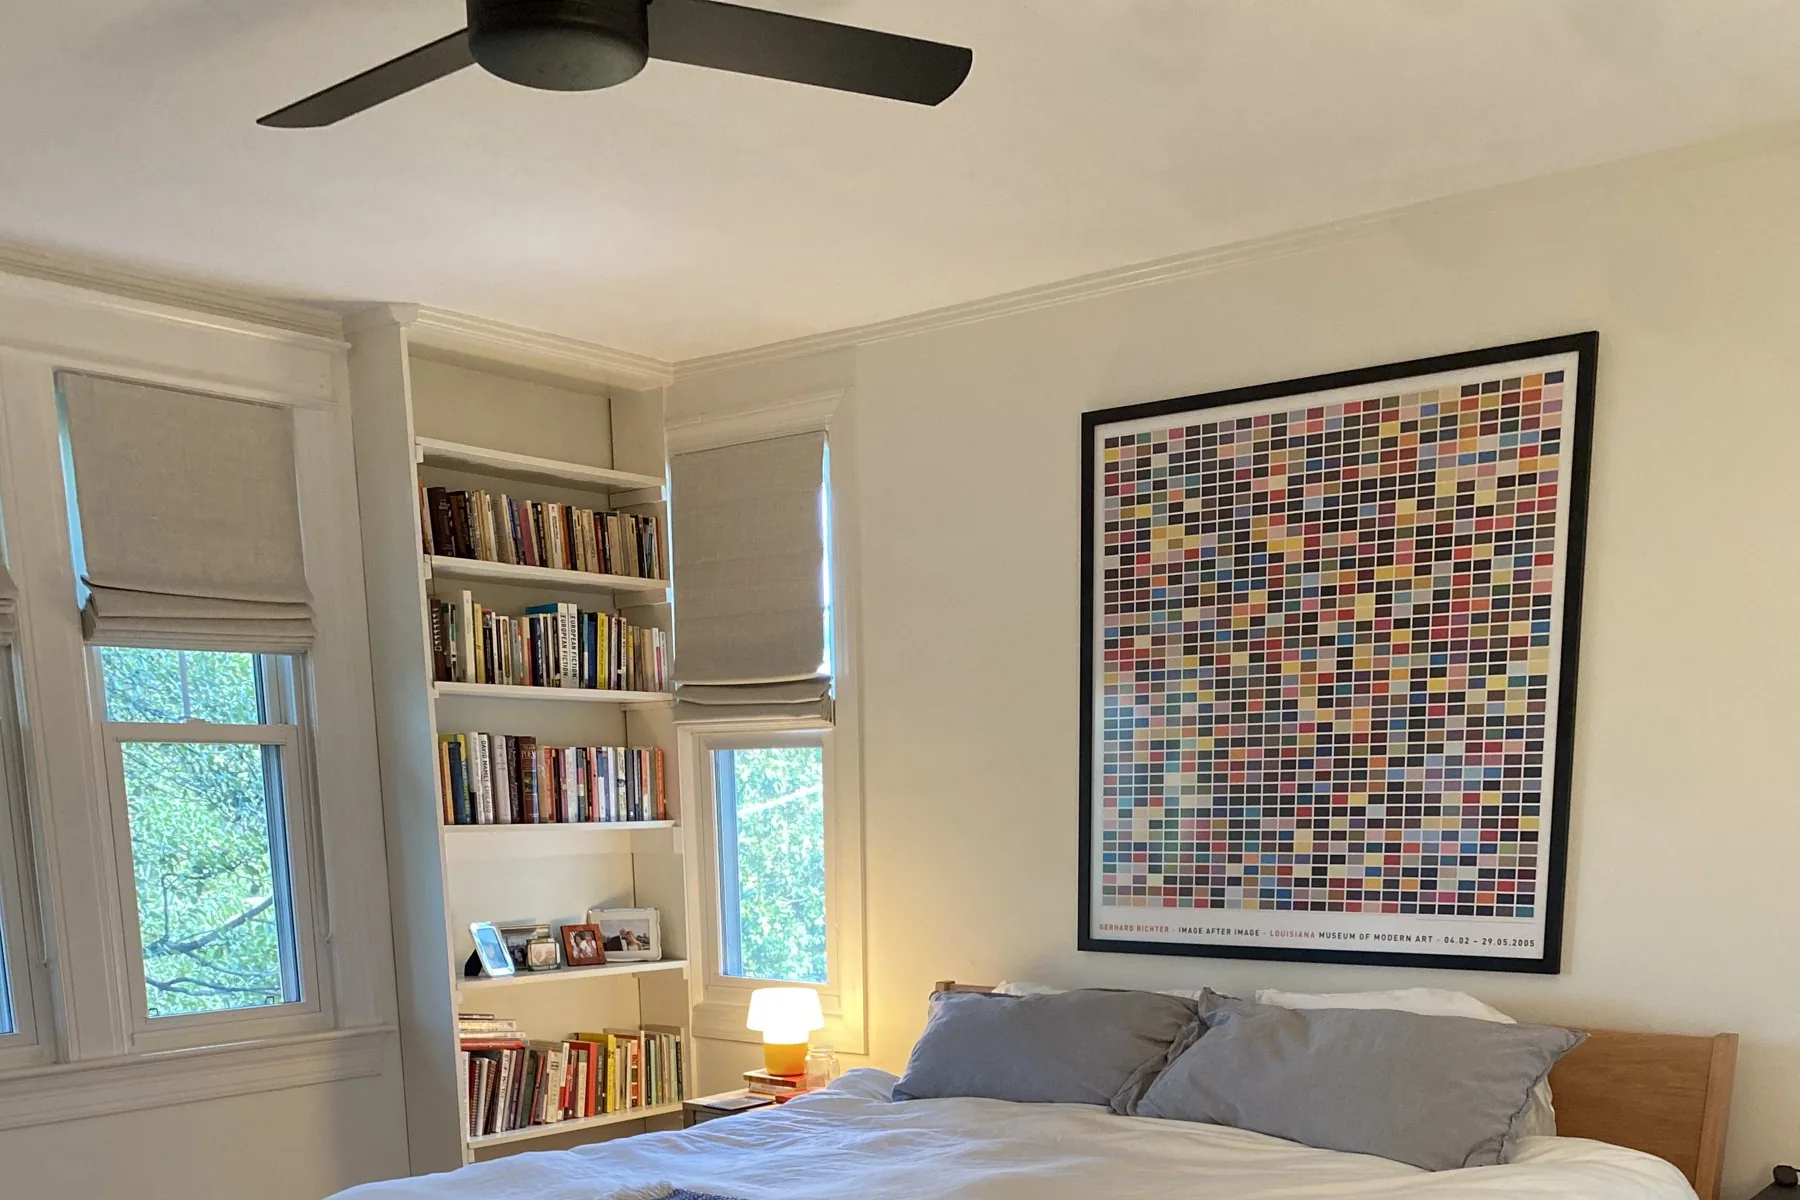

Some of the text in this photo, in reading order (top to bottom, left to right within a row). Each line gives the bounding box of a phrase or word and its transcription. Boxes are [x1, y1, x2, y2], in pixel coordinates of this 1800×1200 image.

[560, 615, 568, 648] EUROPEAN
[1099, 923, 1134, 932] GERHARD
[1136, 925, 1169, 933] RICHTER
[1178, 926, 1203, 934] IMAGE
[1205, 927, 1231, 935] AFTER
[1234, 928, 1260, 937] IMAGE
[1269, 930, 1315, 938] LOUISIANA
[1318, 931, 1356, 940] MUSEUM
[1373, 933, 1411, 942] MODERN
[1414, 935, 1433, 943] ART
[1444, 936, 1469, 945] 04.02
[1482, 938, 1535, 947] 29.05.2005
